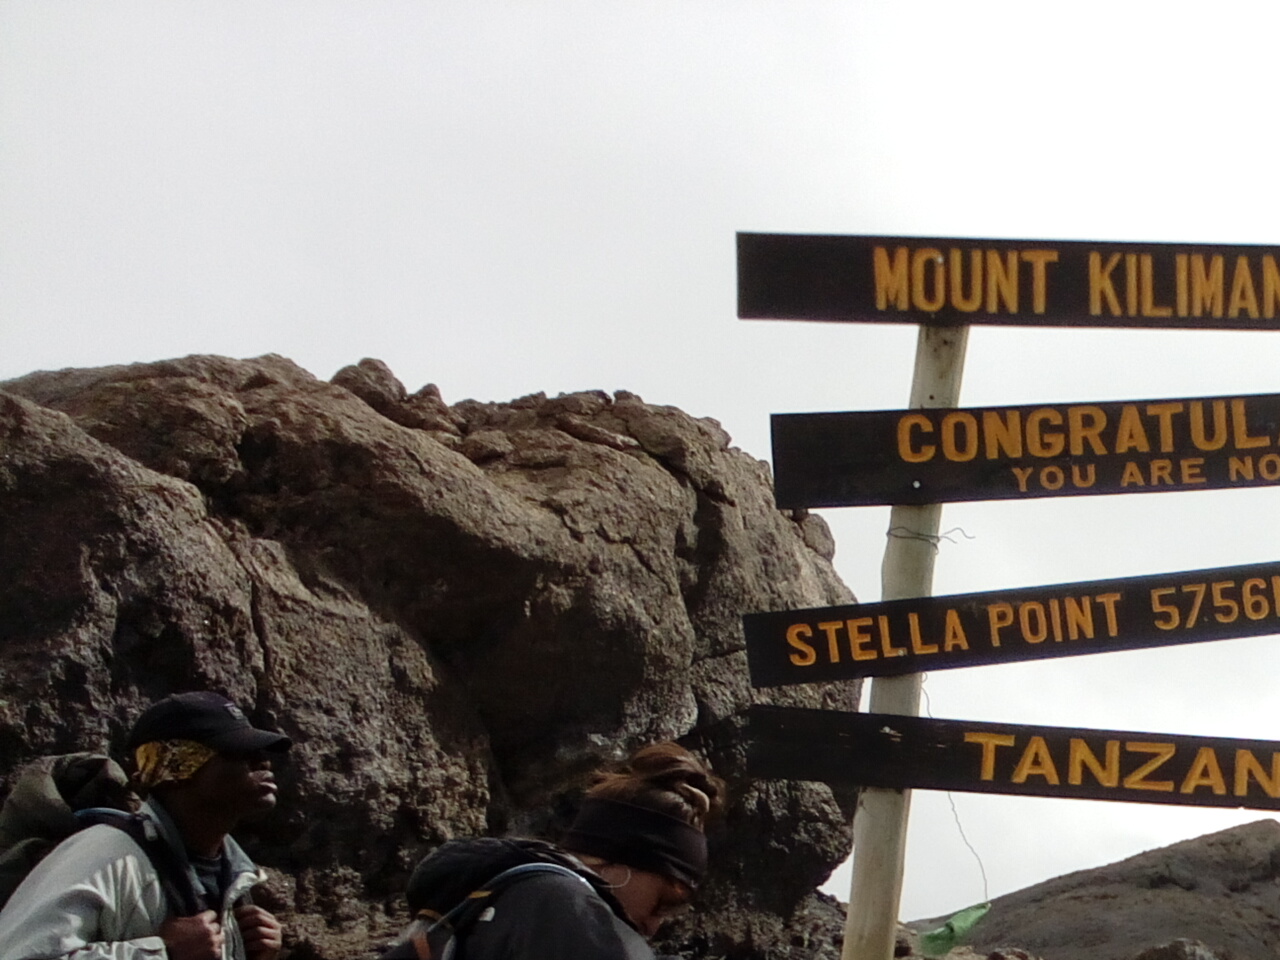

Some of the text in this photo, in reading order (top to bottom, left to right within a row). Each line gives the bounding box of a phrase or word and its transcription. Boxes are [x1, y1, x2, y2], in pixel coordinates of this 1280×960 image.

[873, 246, 1059, 315] MOUNT
[1011, 463, 1096, 491] YOU
[1120, 457, 1207, 487] ARE
[786, 609, 970, 667] STELLA
[986, 593, 1122, 647] POINT
